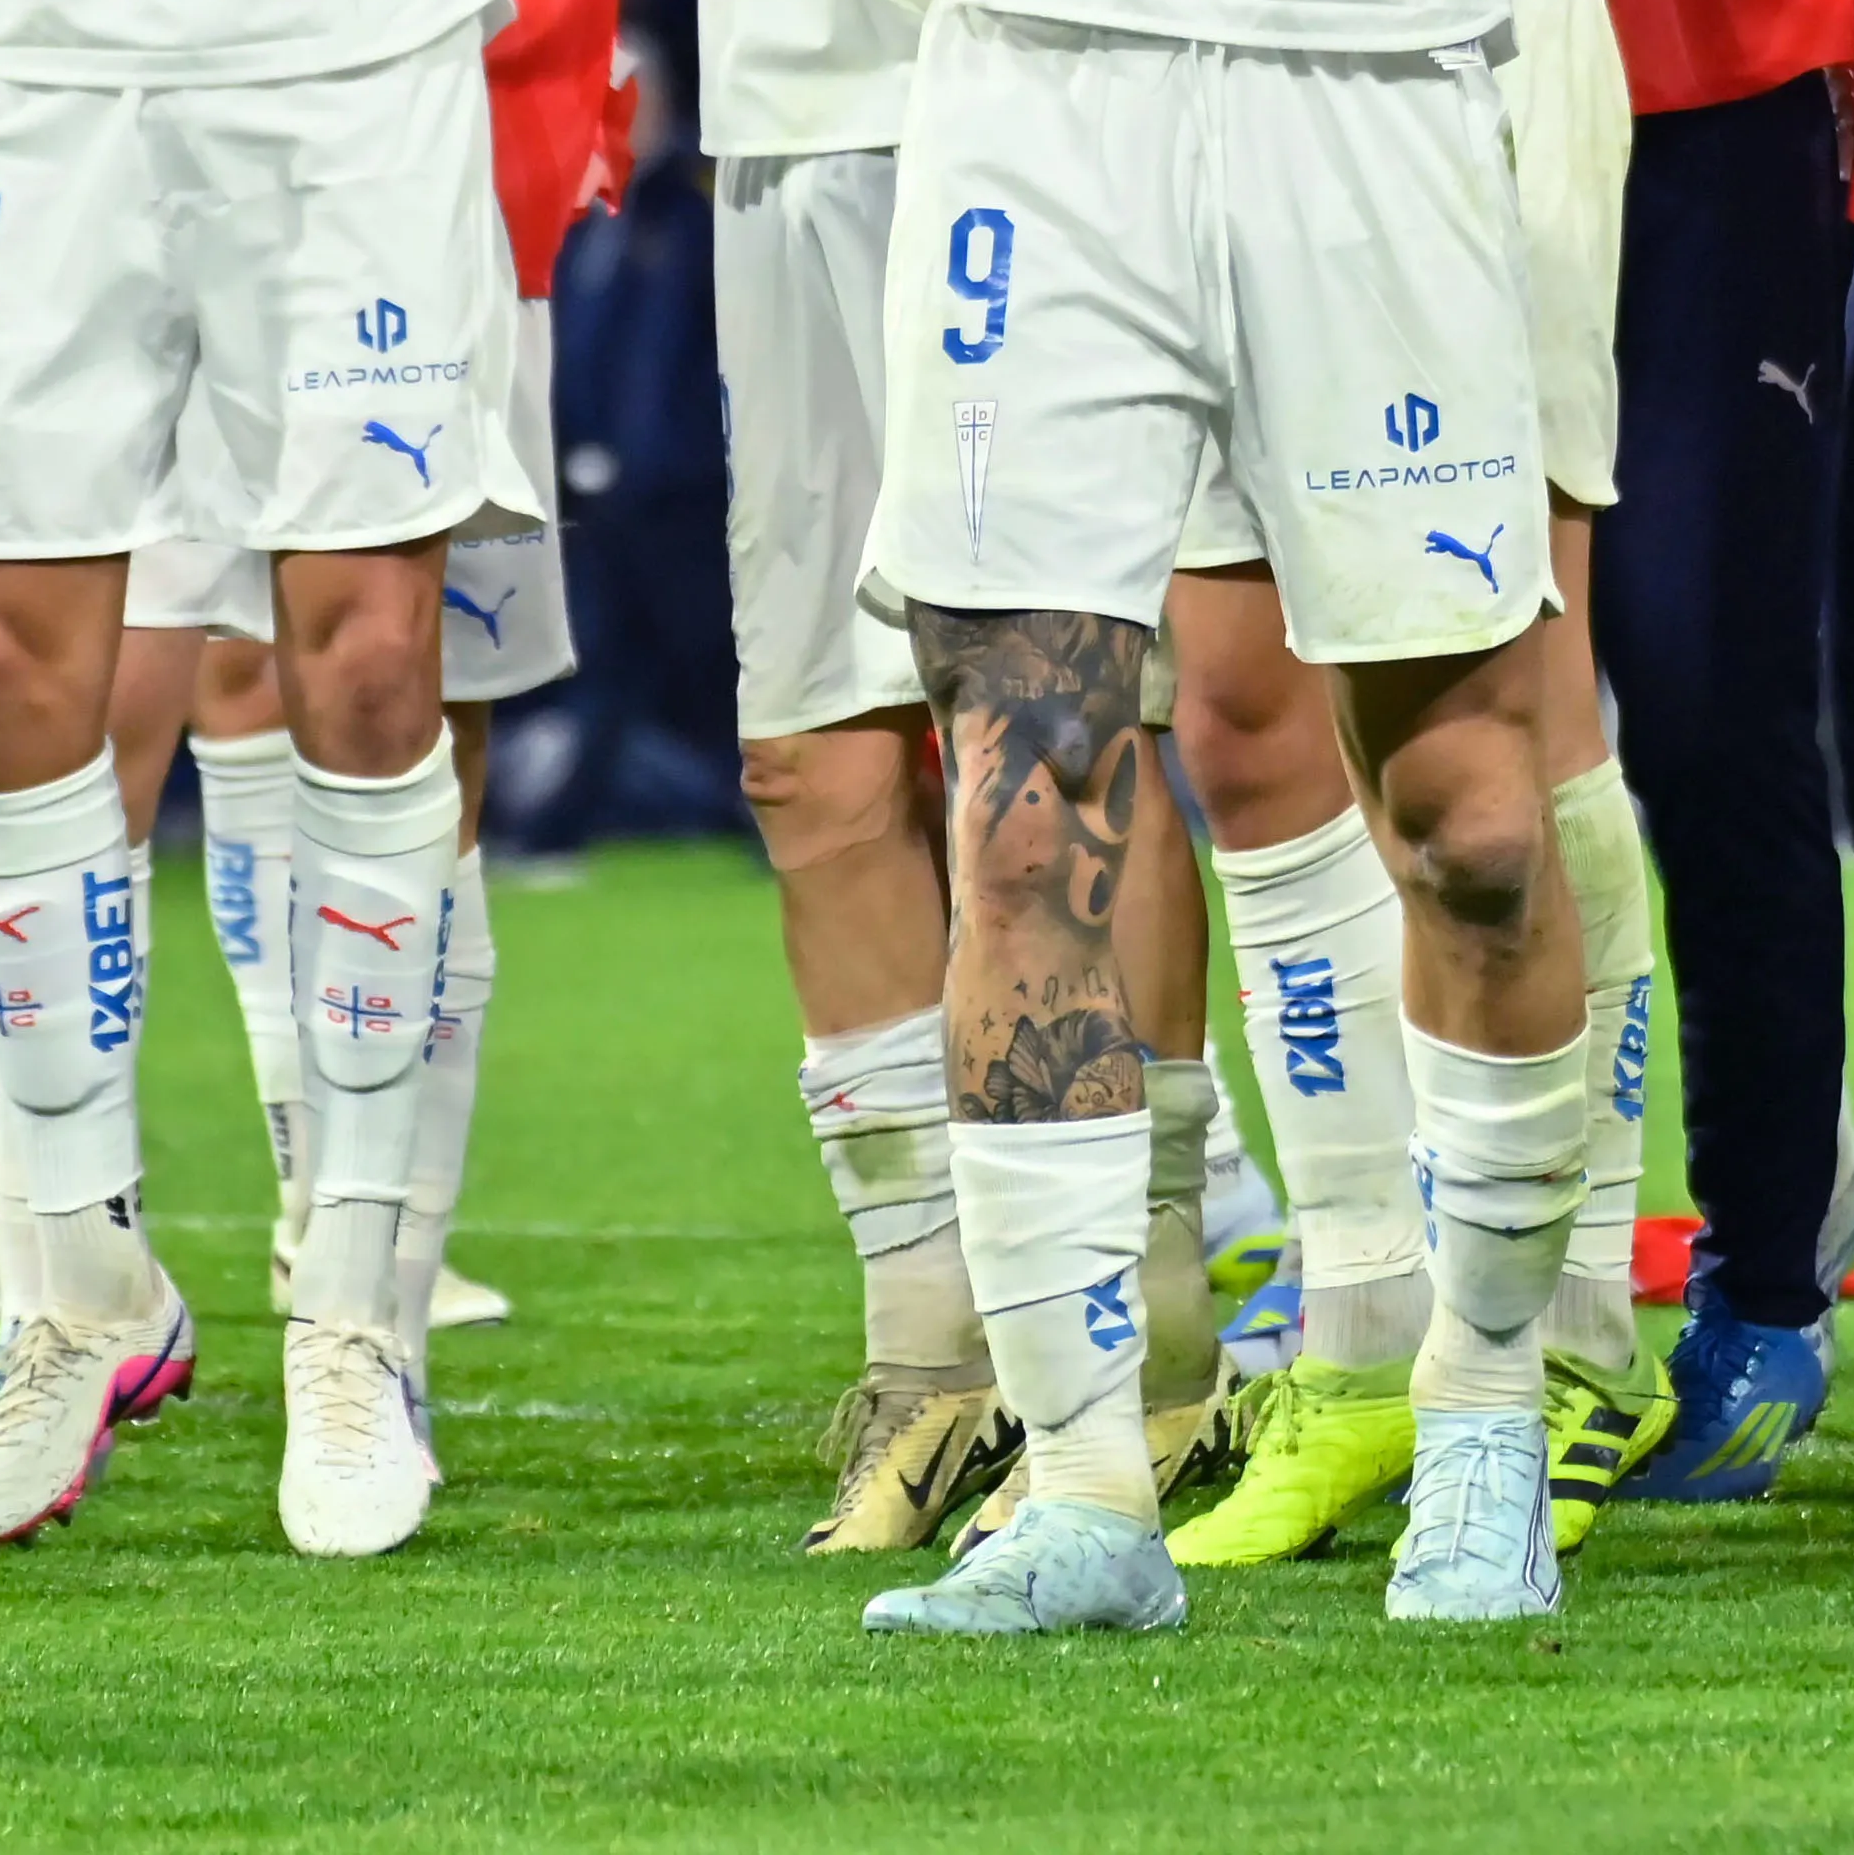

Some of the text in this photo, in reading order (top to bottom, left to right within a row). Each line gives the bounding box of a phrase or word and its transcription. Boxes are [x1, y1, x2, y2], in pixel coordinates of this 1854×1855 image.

[942, 207, 1015, 365] 9
[1306, 455, 1516, 492] LEAPMOTOR
[82, 872, 133, 1053] 1XBET
